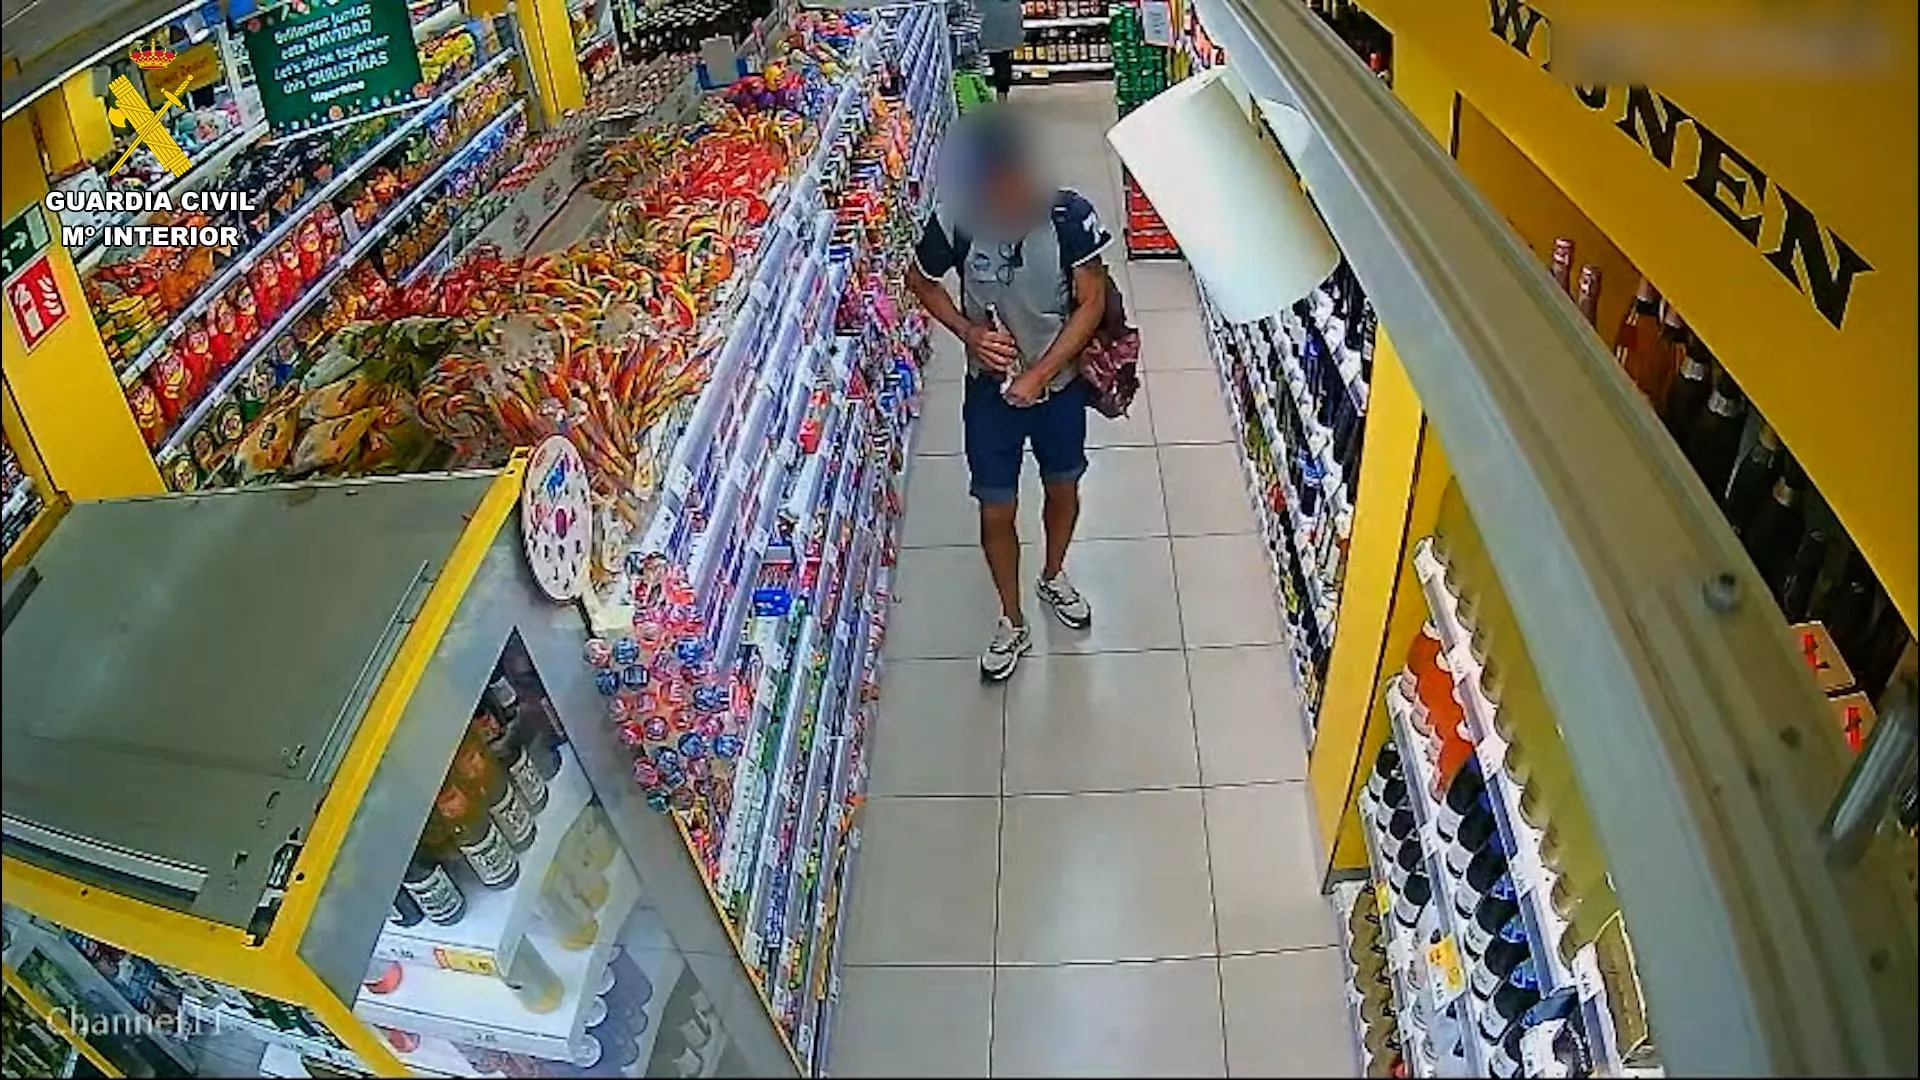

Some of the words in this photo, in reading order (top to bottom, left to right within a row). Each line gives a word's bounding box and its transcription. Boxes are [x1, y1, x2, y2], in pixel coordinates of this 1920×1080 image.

[306, 19, 372, 50] NAVIDAD
[274, 62, 301, 81] Let's
[302, 53, 335, 71] shine
[335, 35, 390, 61] together
[283, 78, 306, 95] this
[306, 50, 390, 87] CHRISTMAS
[1488, 0, 1877, 332] WNEN
